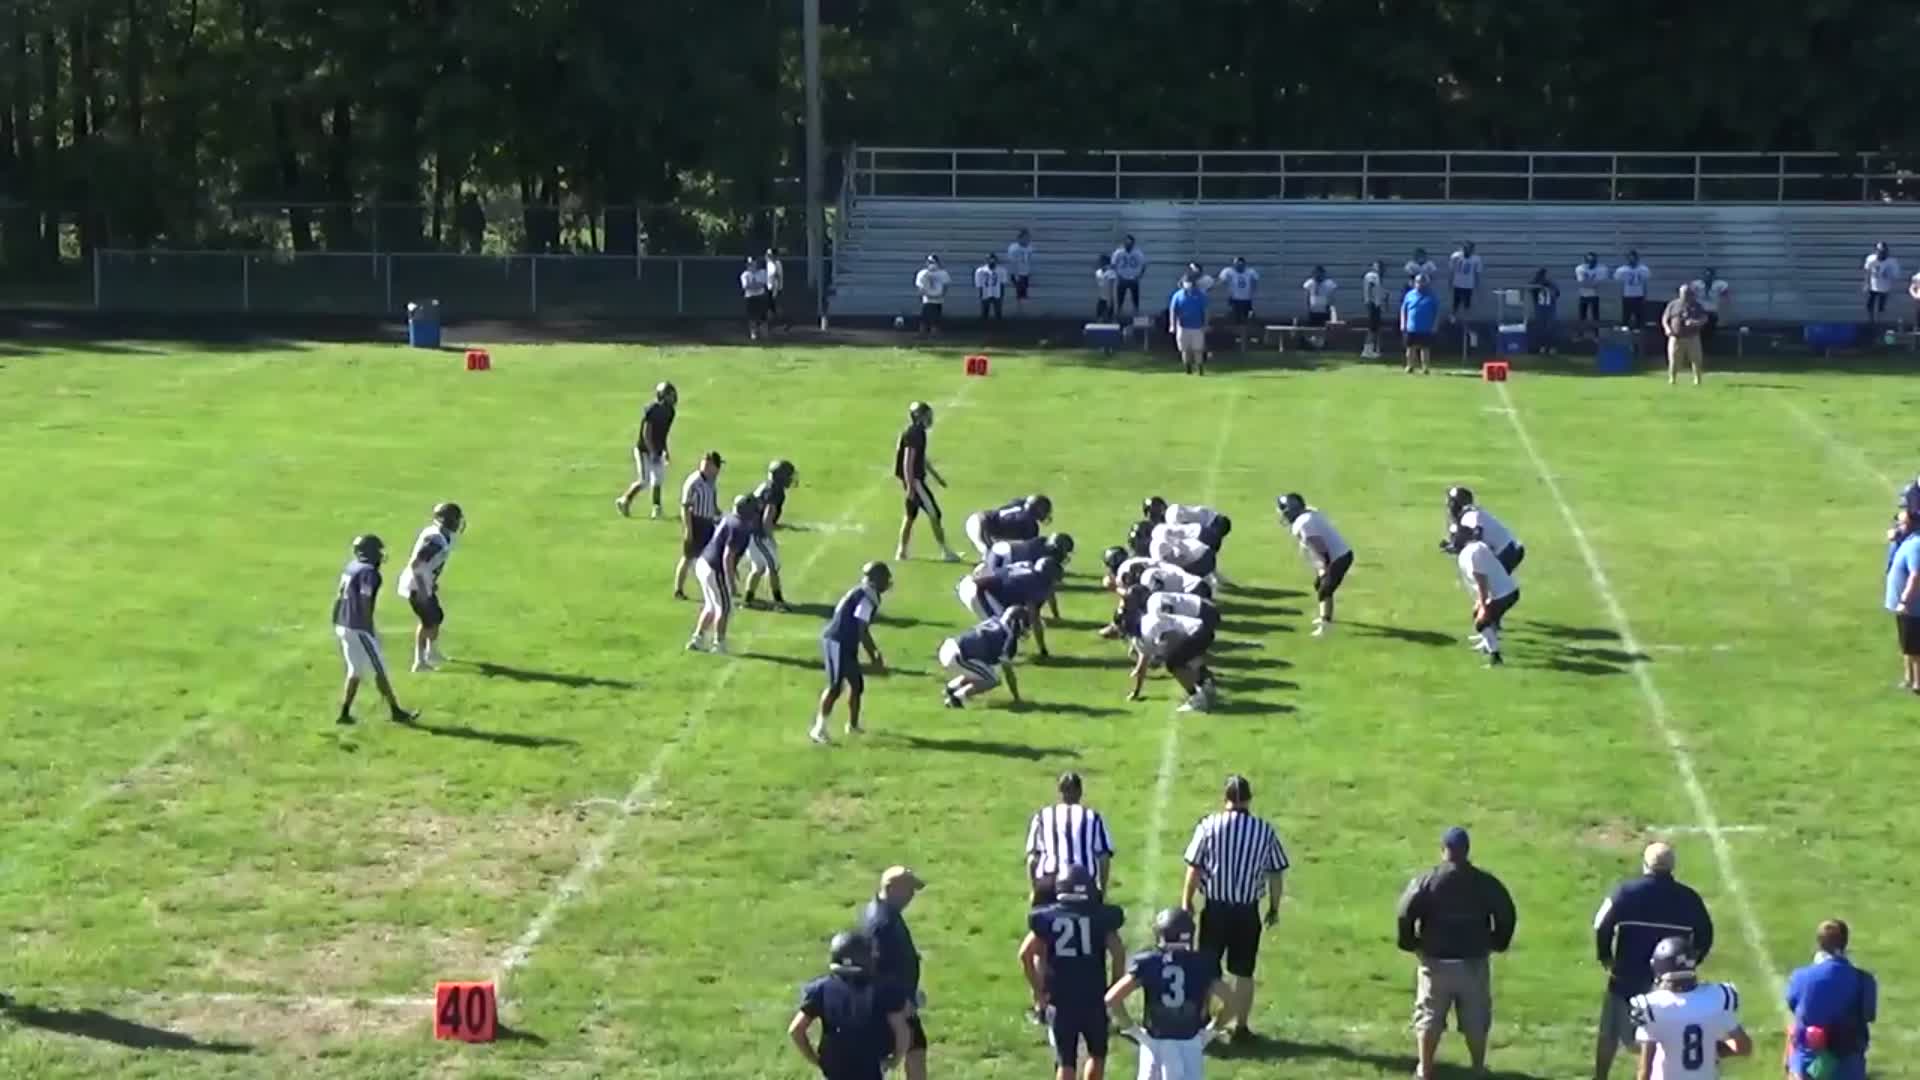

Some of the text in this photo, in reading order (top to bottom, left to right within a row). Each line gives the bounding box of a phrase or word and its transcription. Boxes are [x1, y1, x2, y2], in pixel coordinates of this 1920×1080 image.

[1052, 916, 1092, 957] 21
[1161, 964, 1186, 1009] 3
[440, 985, 487, 1035] 40
[1682, 1023, 1704, 1071] 8
